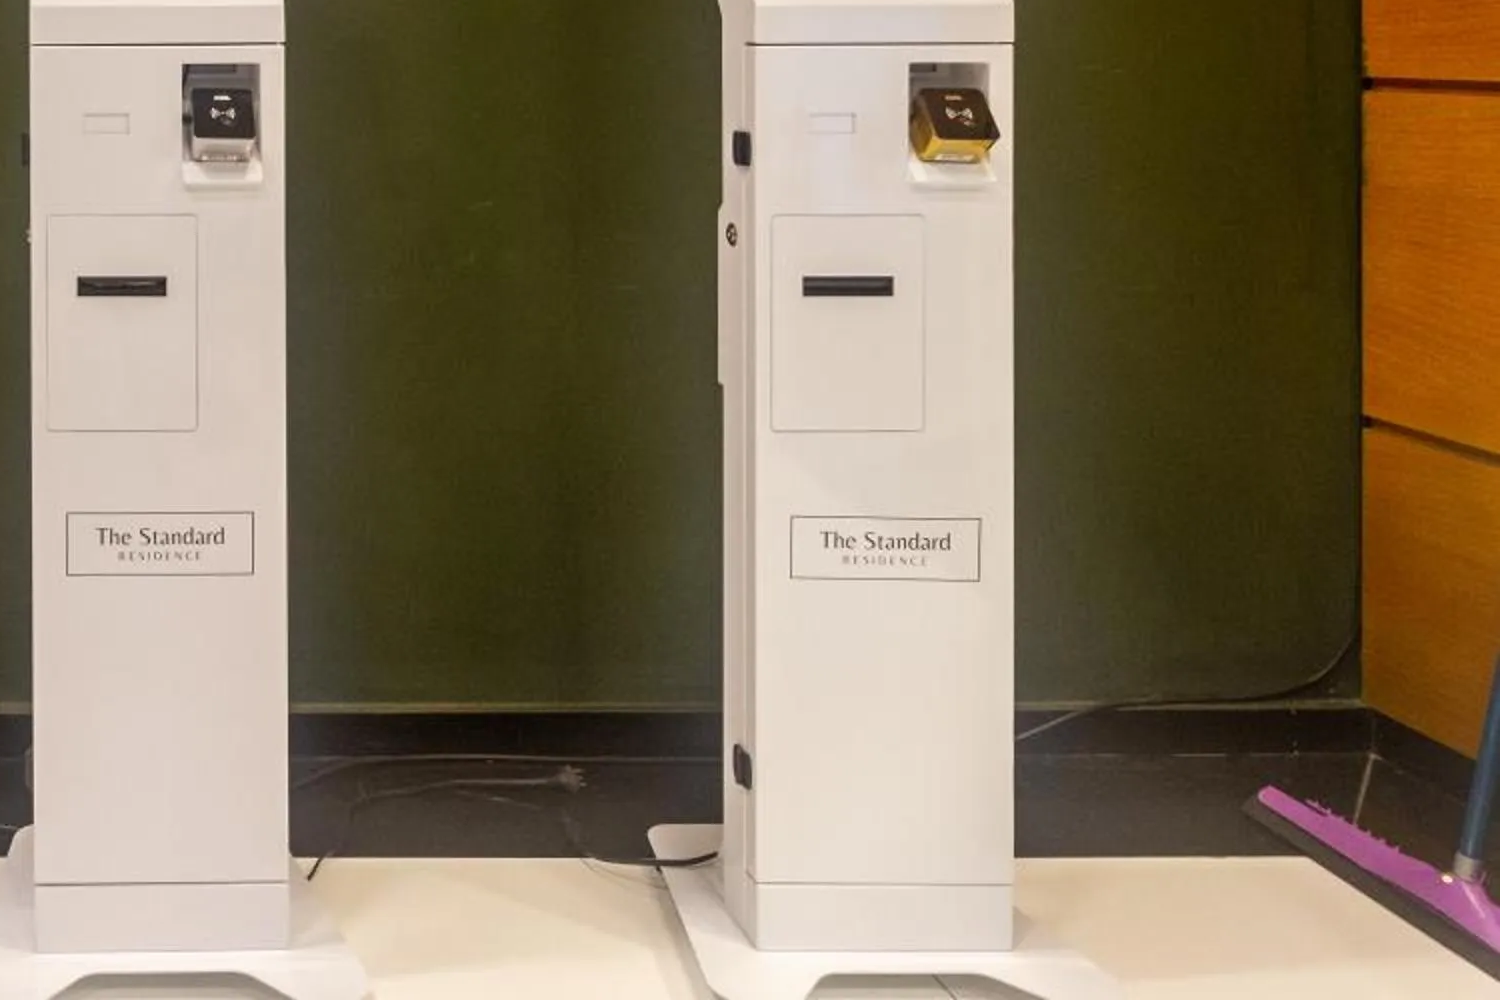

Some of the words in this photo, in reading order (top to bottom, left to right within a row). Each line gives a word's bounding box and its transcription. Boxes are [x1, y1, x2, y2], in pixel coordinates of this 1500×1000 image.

[95, 527, 132, 546] The
[139, 526, 226, 546] Standard
[820, 530, 857, 549] The
[864, 530, 952, 551] Standard
[118, 551, 201, 561] RESIDENCE
[842, 555, 927, 567] RESIDENCE
